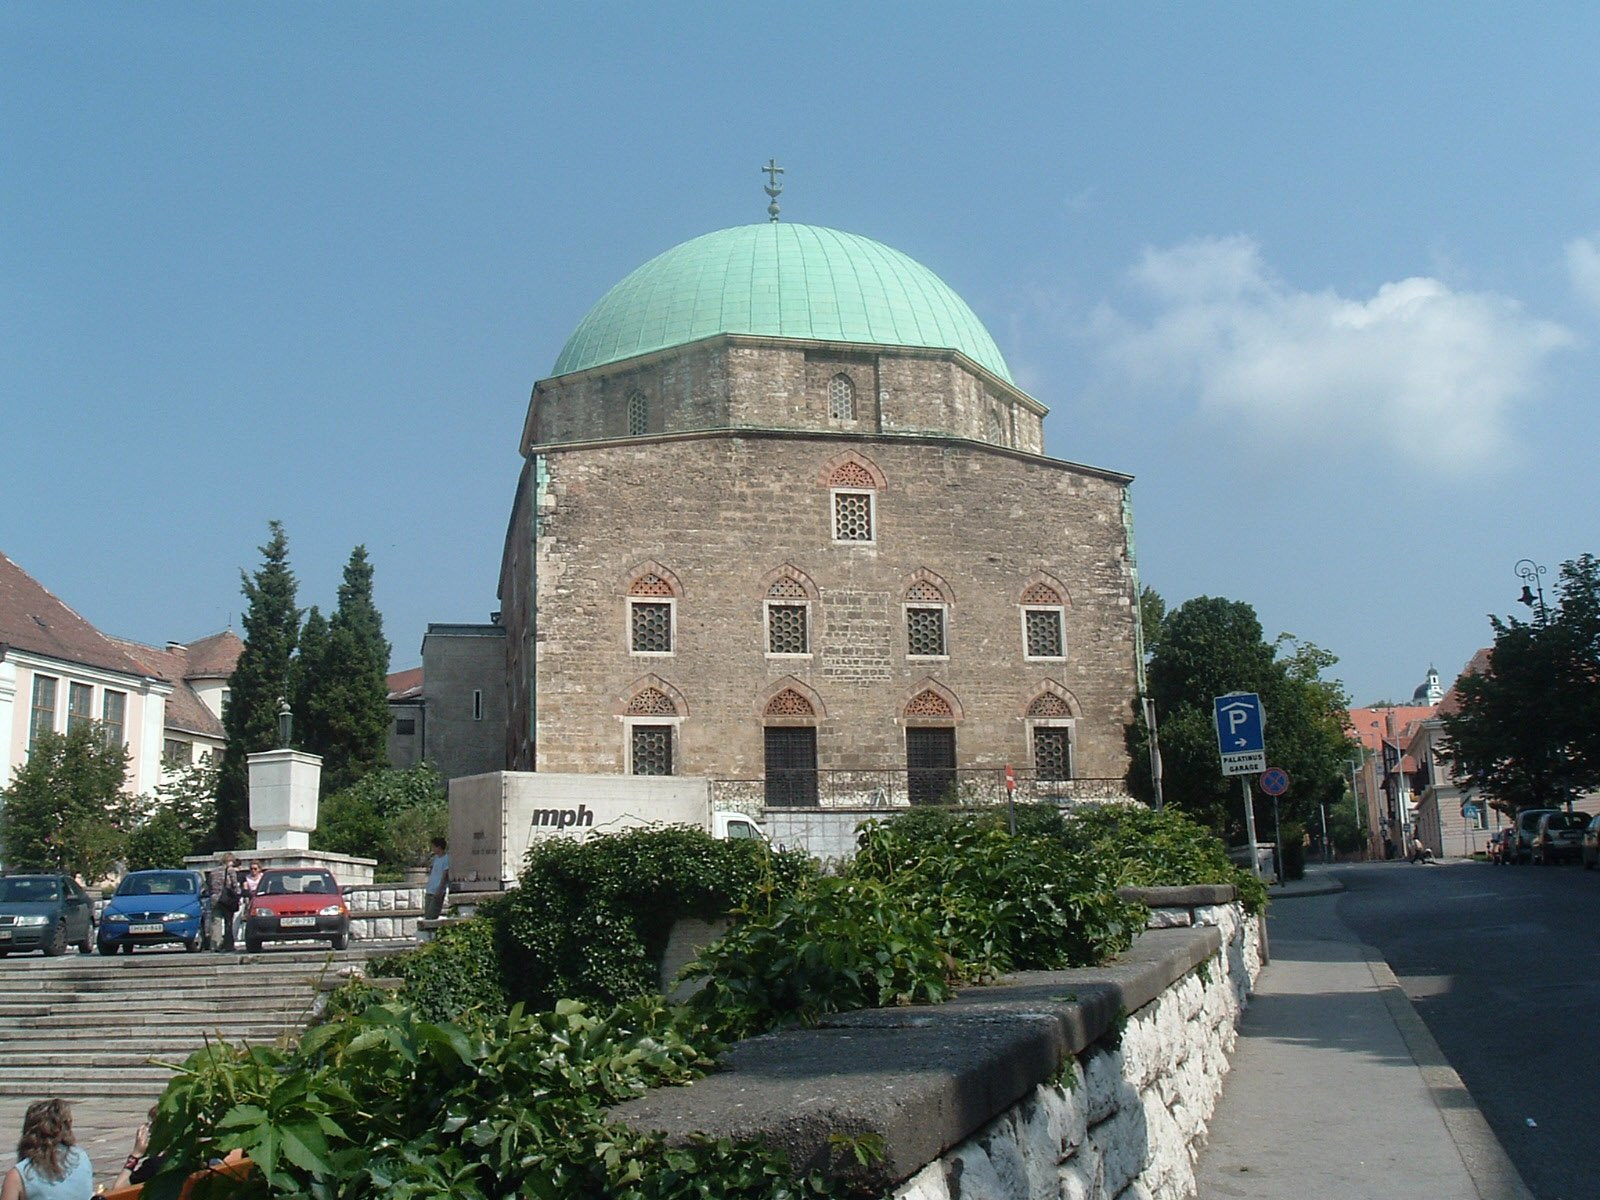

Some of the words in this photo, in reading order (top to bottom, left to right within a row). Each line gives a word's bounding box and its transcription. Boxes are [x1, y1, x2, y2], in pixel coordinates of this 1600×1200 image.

[1228, 709, 1248, 734] P
[1223, 754, 1262, 763] PALATINUS
[1229, 764, 1259, 772] GARAGE
[531, 804, 594, 829] mph
